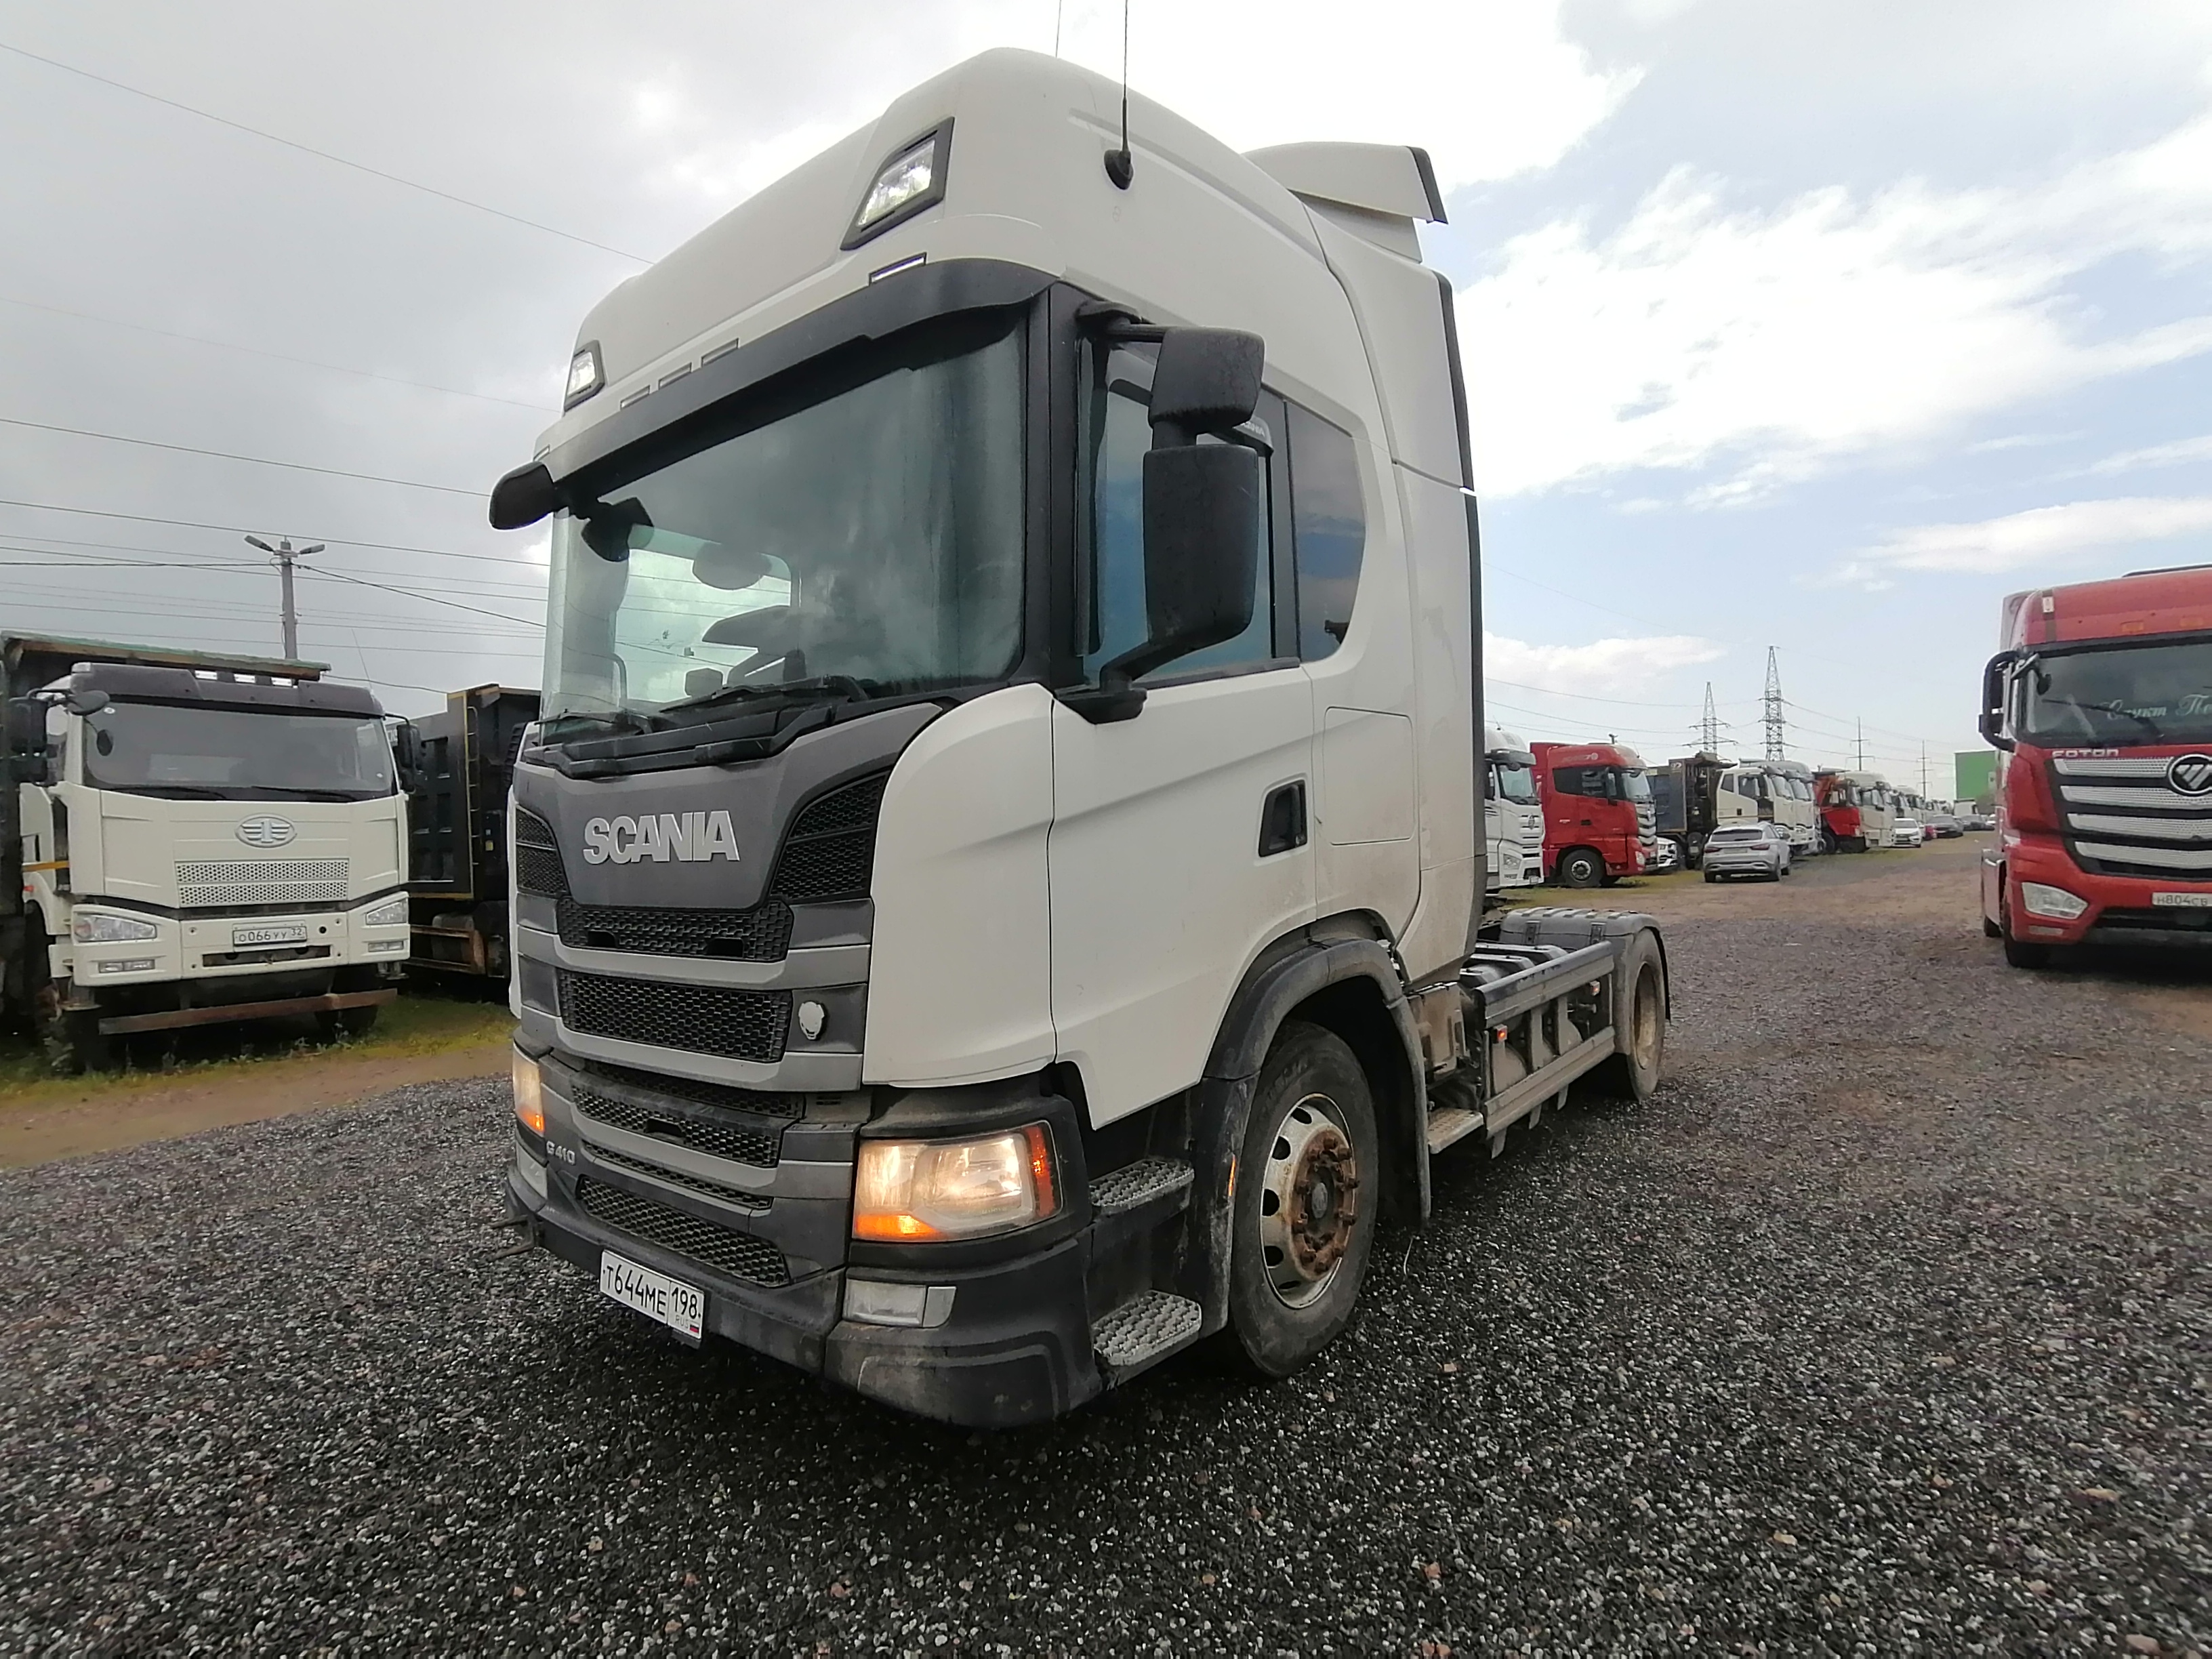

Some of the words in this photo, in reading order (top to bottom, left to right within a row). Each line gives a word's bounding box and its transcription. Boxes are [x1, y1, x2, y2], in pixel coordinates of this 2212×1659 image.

[2052, 748, 2119, 758] FOTON
[583, 810, 740, 864] SCANIA
[546, 1140, 575, 1166] G410
[672, 1286, 697, 1319] 198
